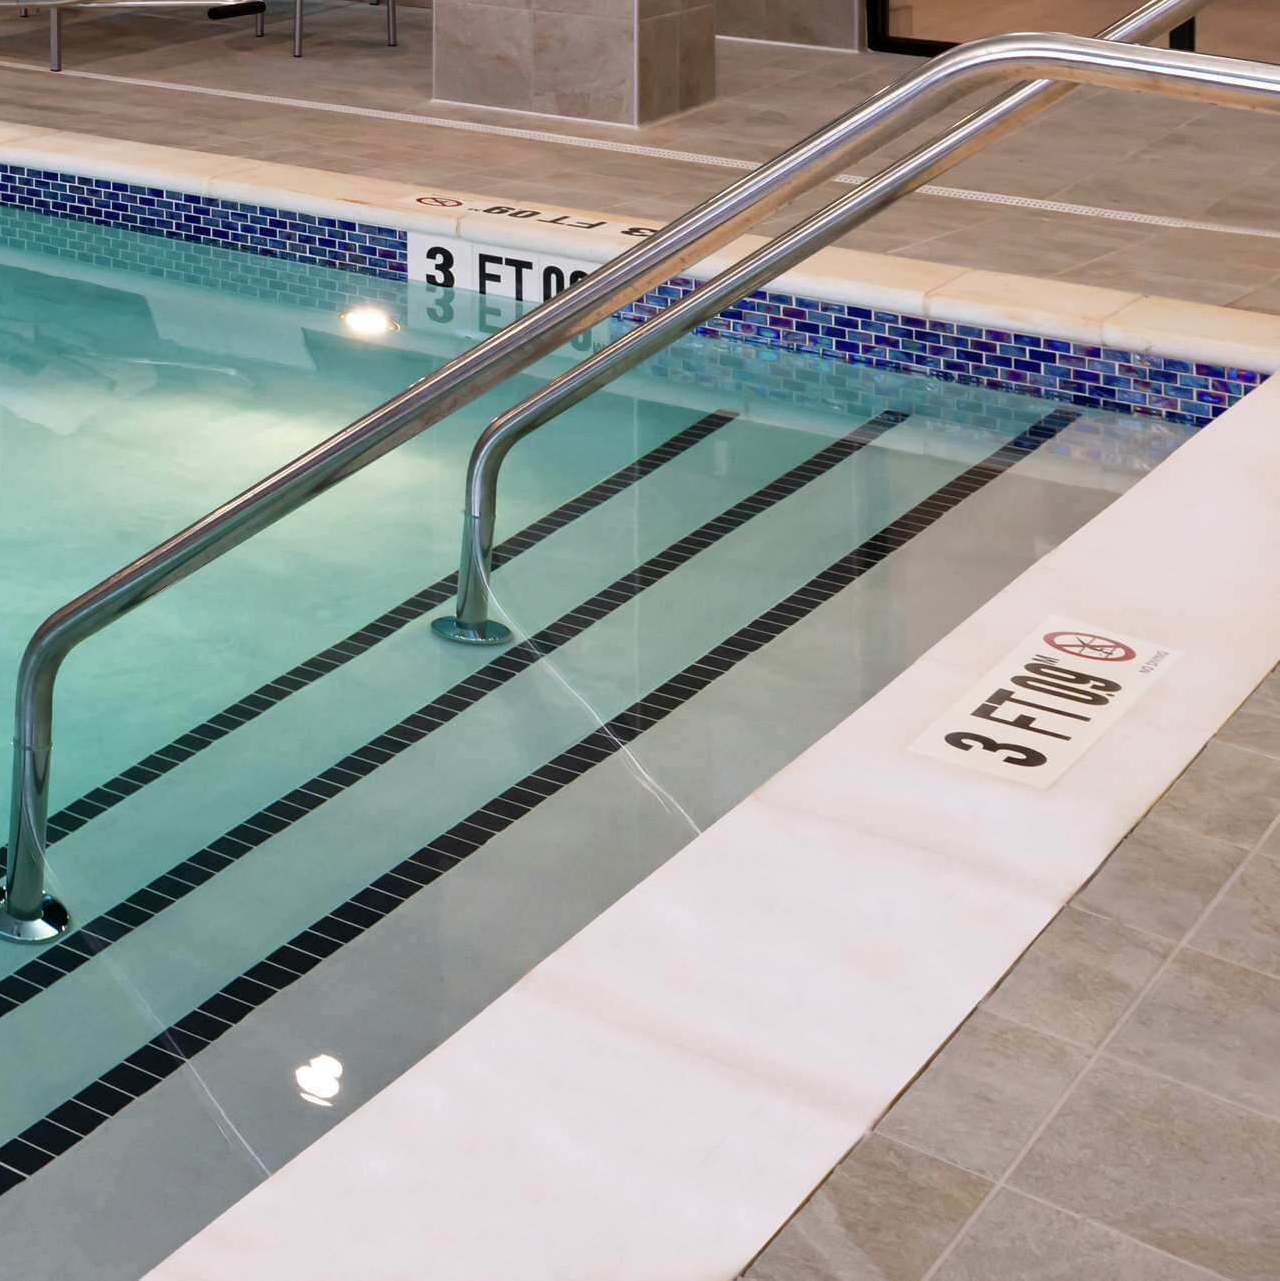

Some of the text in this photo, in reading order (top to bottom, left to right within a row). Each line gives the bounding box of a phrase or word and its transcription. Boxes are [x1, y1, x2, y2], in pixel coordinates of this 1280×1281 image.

[425, 246, 455, 288] 3
[479, 253, 533, 301] FT
[970, 688, 1091, 741] FT
[944, 731, 1048, 767] 3
